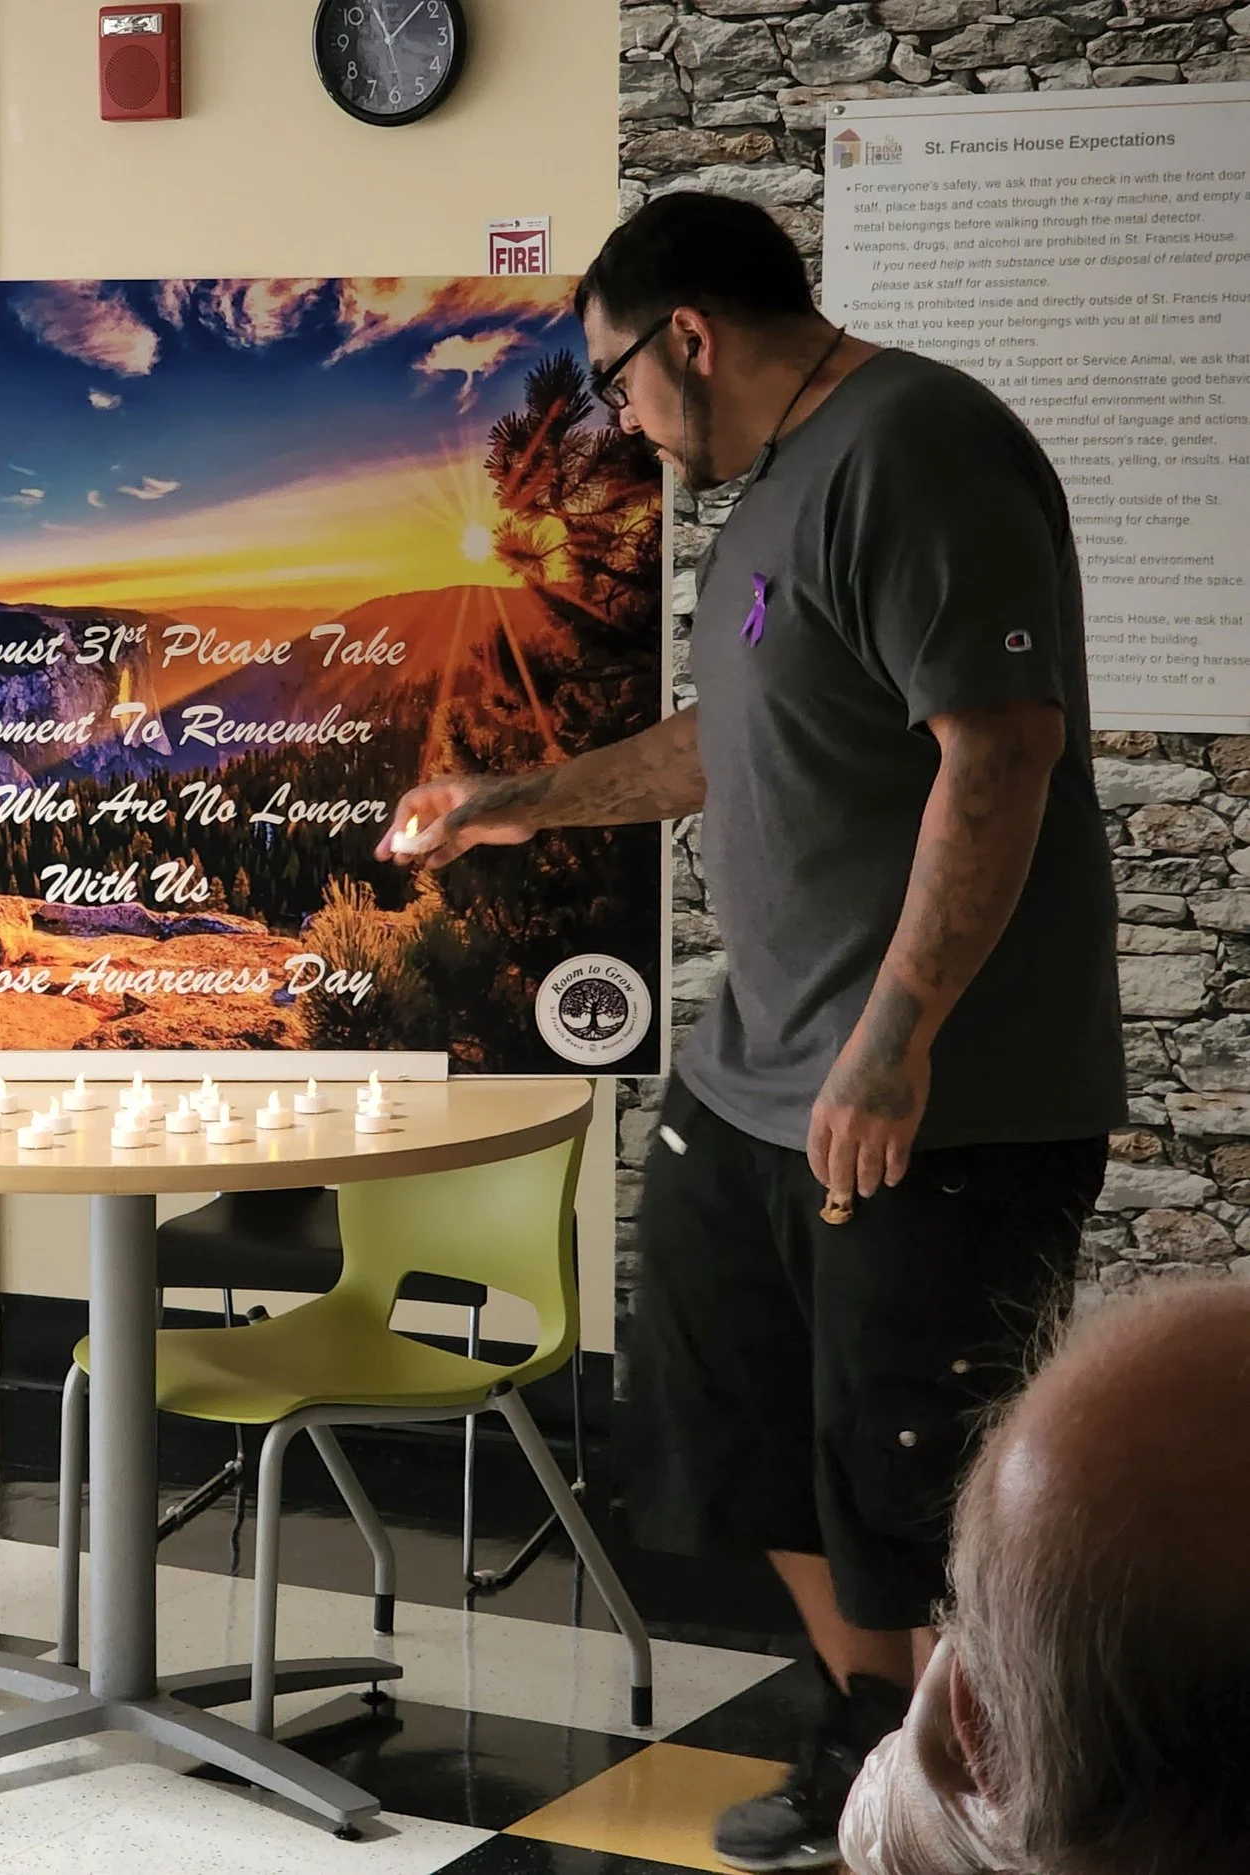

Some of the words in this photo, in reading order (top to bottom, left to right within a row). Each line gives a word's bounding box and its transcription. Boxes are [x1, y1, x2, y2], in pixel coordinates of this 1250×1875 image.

[344, 7, 364, 26] 10
[427, 1, 439, 18] 2
[337, 34, 349, 52] 9
[438, 27, 448, 45] 3
[347, 61, 358, 79] 8
[429, 56, 441, 74] 4
[367, 80, 377, 98] 7
[389, 85, 401, 104] 6
[415, 77, 424, 95] 5
[924, 141, 945, 155] St.
[950, 138, 1007, 154] Francis
[1013, 137, 1064, 151] House
[1069, 132, 1175, 151] Expectations
[855, 183, 873, 192] For
[877, 181, 939, 195] everyone's
[943, 179, 981, 192] safety,
[1005, 177, 1025, 188] ask
[1029, 176, 1051, 187] that
[1056, 177, 1077, 189] you
[1081, 173, 1116, 185] check
[1120, 173, 1130, 183] in
[1134, 171, 1159, 183] with
[1163, 171, 1181, 182] the
[1186, 170, 1215, 181] front
[1218, 170, 1246, 181] door
[854, 201, 881, 213] staff,
[886, 201, 916, 214] place
[920, 200, 947, 213] bags
[952, 199, 973, 210] and
[977, 198, 1008, 209] coats
[1012, 195, 1056, 209] through
[1061, 195, 1079, 206] the
[1083, 196, 1114, 208] x-ray
[1117, 193, 1172, 205] machine,
[1176, 191, 1199, 202] and
[1203, 190, 1240, 203] empty
[854, 221, 884, 233] metal
[888, 219, 950, 233] belongings
[954, 217, 990, 229] before
[995, 216, 1038, 230] walking
[1042, 214, 1087, 229] through
[1092, 214, 1110, 225] the
[1114, 213, 1147, 224] metal
[1151, 212, 1205, 224] detector.
[853, 241, 910, 253] Weapons,
[913, 239, 949, 251] drugs,
[953, 238, 974, 249] and
[978, 237, 1020, 248] alcohol
[1024, 238, 1042, 247] are
[1046, 234, 1105, 248] prohibited
[1110, 234, 1120, 245] in
[1125, 233, 1140, 244] St.
[1146, 232, 1190, 244] Francis
[1194, 231, 1237, 242] House.
[495, 246, 540, 274] FIRE
[884, 262, 904, 272] you
[907, 259, 936, 270] need
[940, 258, 964, 270] help
[968, 258, 991, 268] with
[995, 257, 1054, 268] substance
[1059, 257, 1080, 267] use
[1084, 257, 1096, 265] or
[1100, 253, 1150, 267] disposal
[1154, 253, 1166, 264] of
[1169, 251, 1212, 263] related
[852, 320, 870, 330] We
[874, 319, 893, 330] ask
[897, 319, 918, 329] that
[922, 320, 943, 331] you
[947, 318, 974, 331] keep
[978, 317, 1003, 330] your
[1007, 315, 1071, 329] belongings
[1075, 315, 1099, 326] with
[1103, 315, 1125, 328] you
[1129, 314, 1140, 325] at
[1144, 314, 1158, 324] all
[1162, 313, 1194, 324] times
[1198, 313, 1221, 323] and
[1072, 494, 1115, 508] directly
[1119, 494, 1163, 505] outside
[1167, 494, 1178, 504] of
[1182, 494, 1201, 505] the
[1205, 495, 1222, 505] St.
[1086, 575, 1097, 584] to
[1102, 576, 1134, 584] move
[1138, 575, 1179, 585] around
[1184, 575, 1202, 585] the
[1207, 577, 1246, 587] space.
[75, 624, 147, 665] 31st
[161, 624, 291, 668] Please
[310, 624, 406, 667] Take
[110, 702, 162, 746] To
[179, 704, 373, 747] Remember
[88, 782, 167, 825] Are
[179, 781, 237, 825] No
[250, 782, 389, 837] Longer
[41, 861, 140, 904] With
[149, 861, 211, 904] Us
[61, 953, 271, 997] Awareness
[283, 953, 374, 1007] Day
[551, 967, 584, 995] Room
[588, 965, 601, 974] to
[605, 966, 635, 993] Grow
